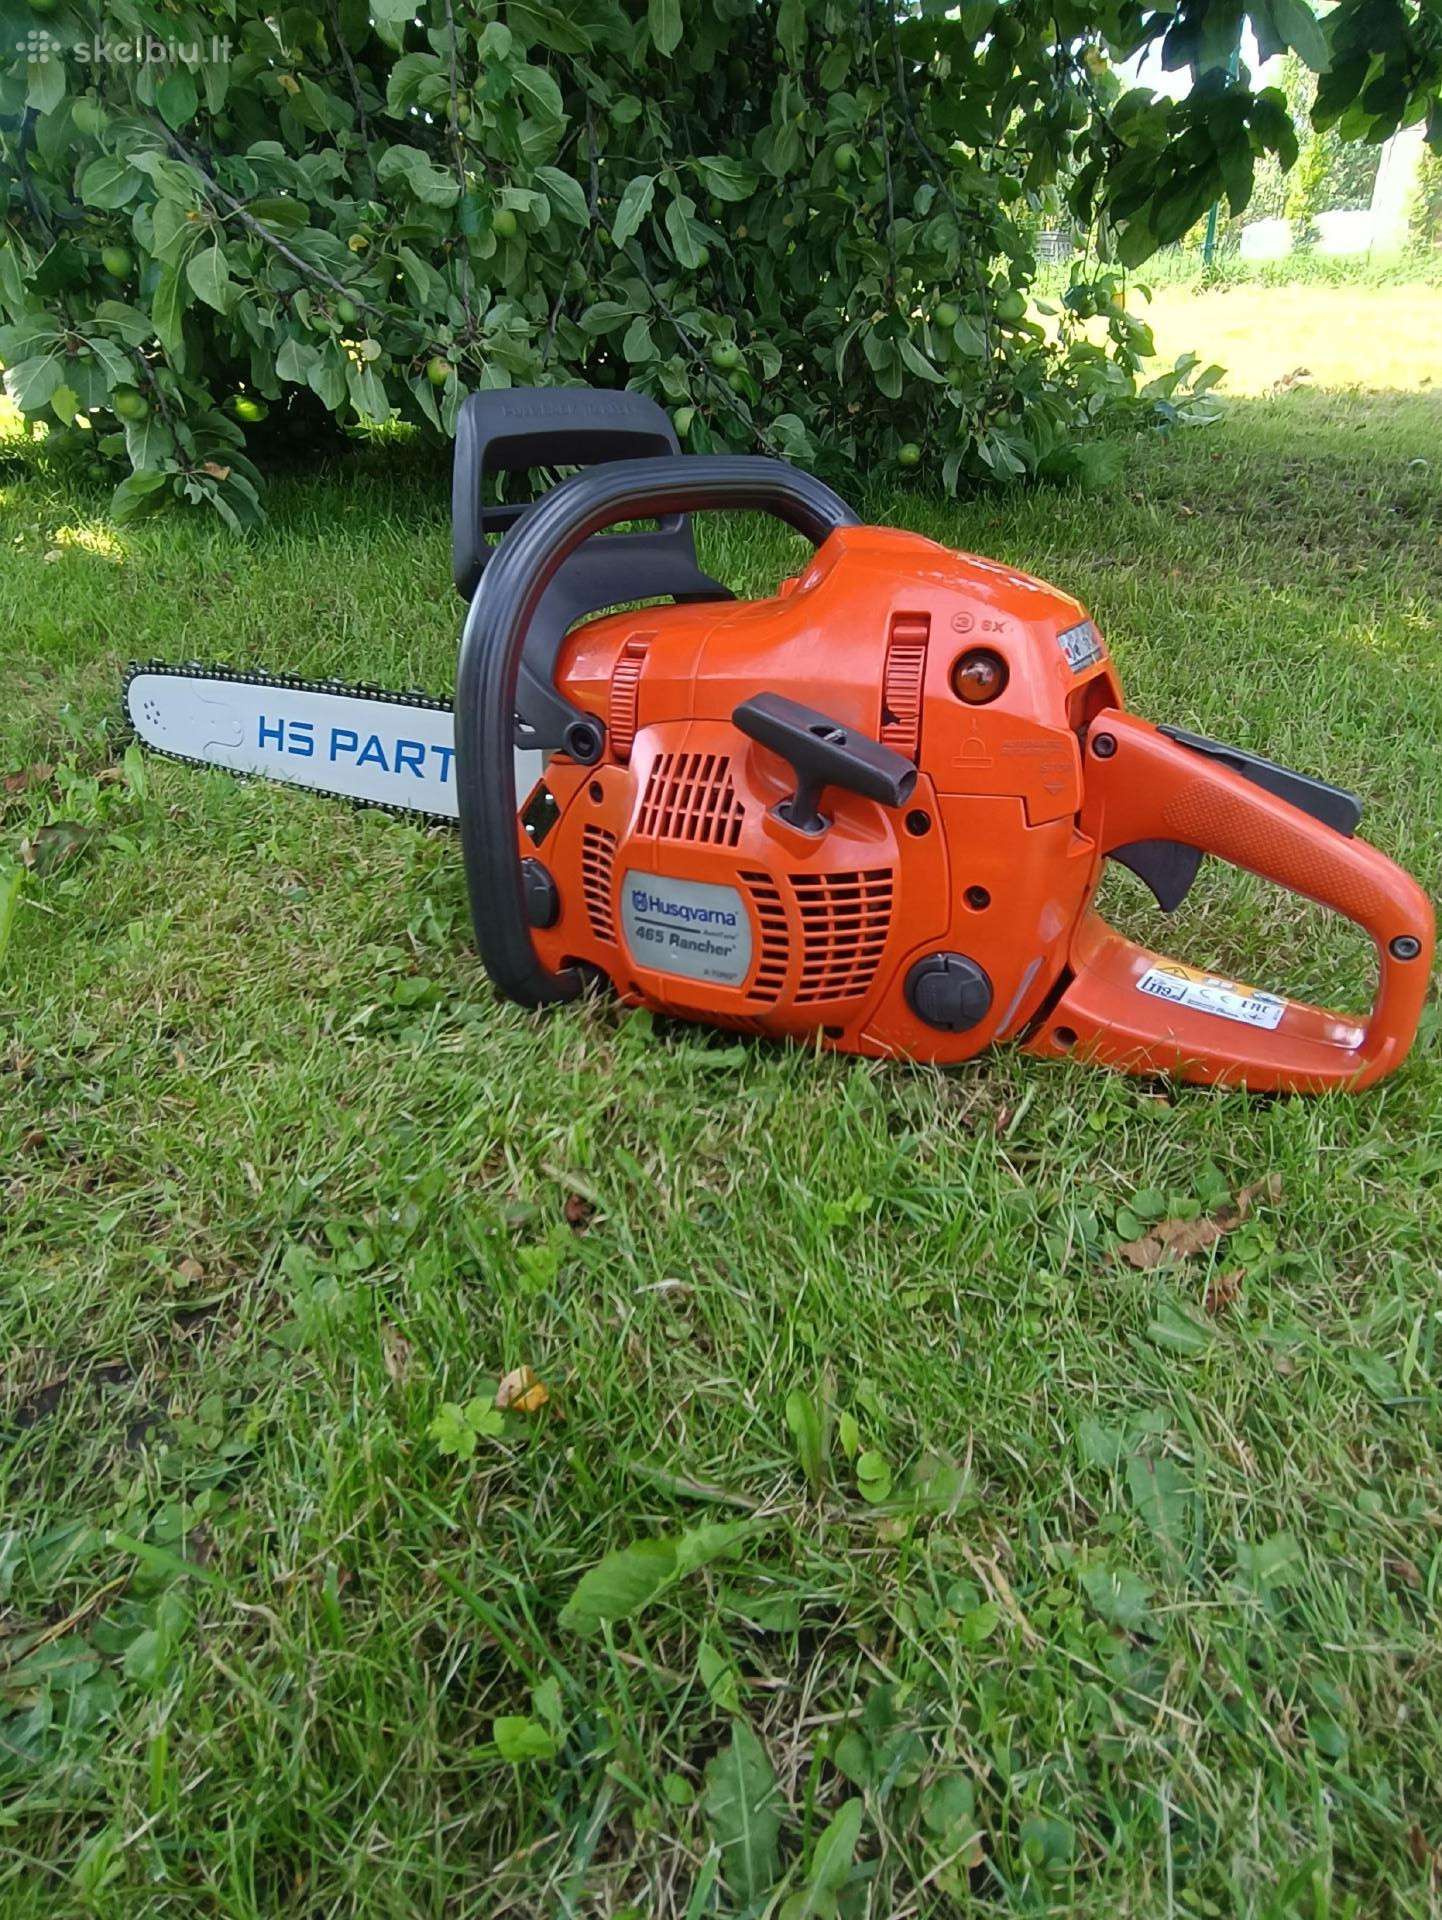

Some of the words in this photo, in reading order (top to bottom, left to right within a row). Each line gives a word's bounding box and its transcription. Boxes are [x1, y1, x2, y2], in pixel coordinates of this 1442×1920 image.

[258, 715, 314, 757] HS
[649, 895, 736, 926] Husqvarna
[635, 925, 664, 944] 465
[669, 932, 732, 957] Rancher
